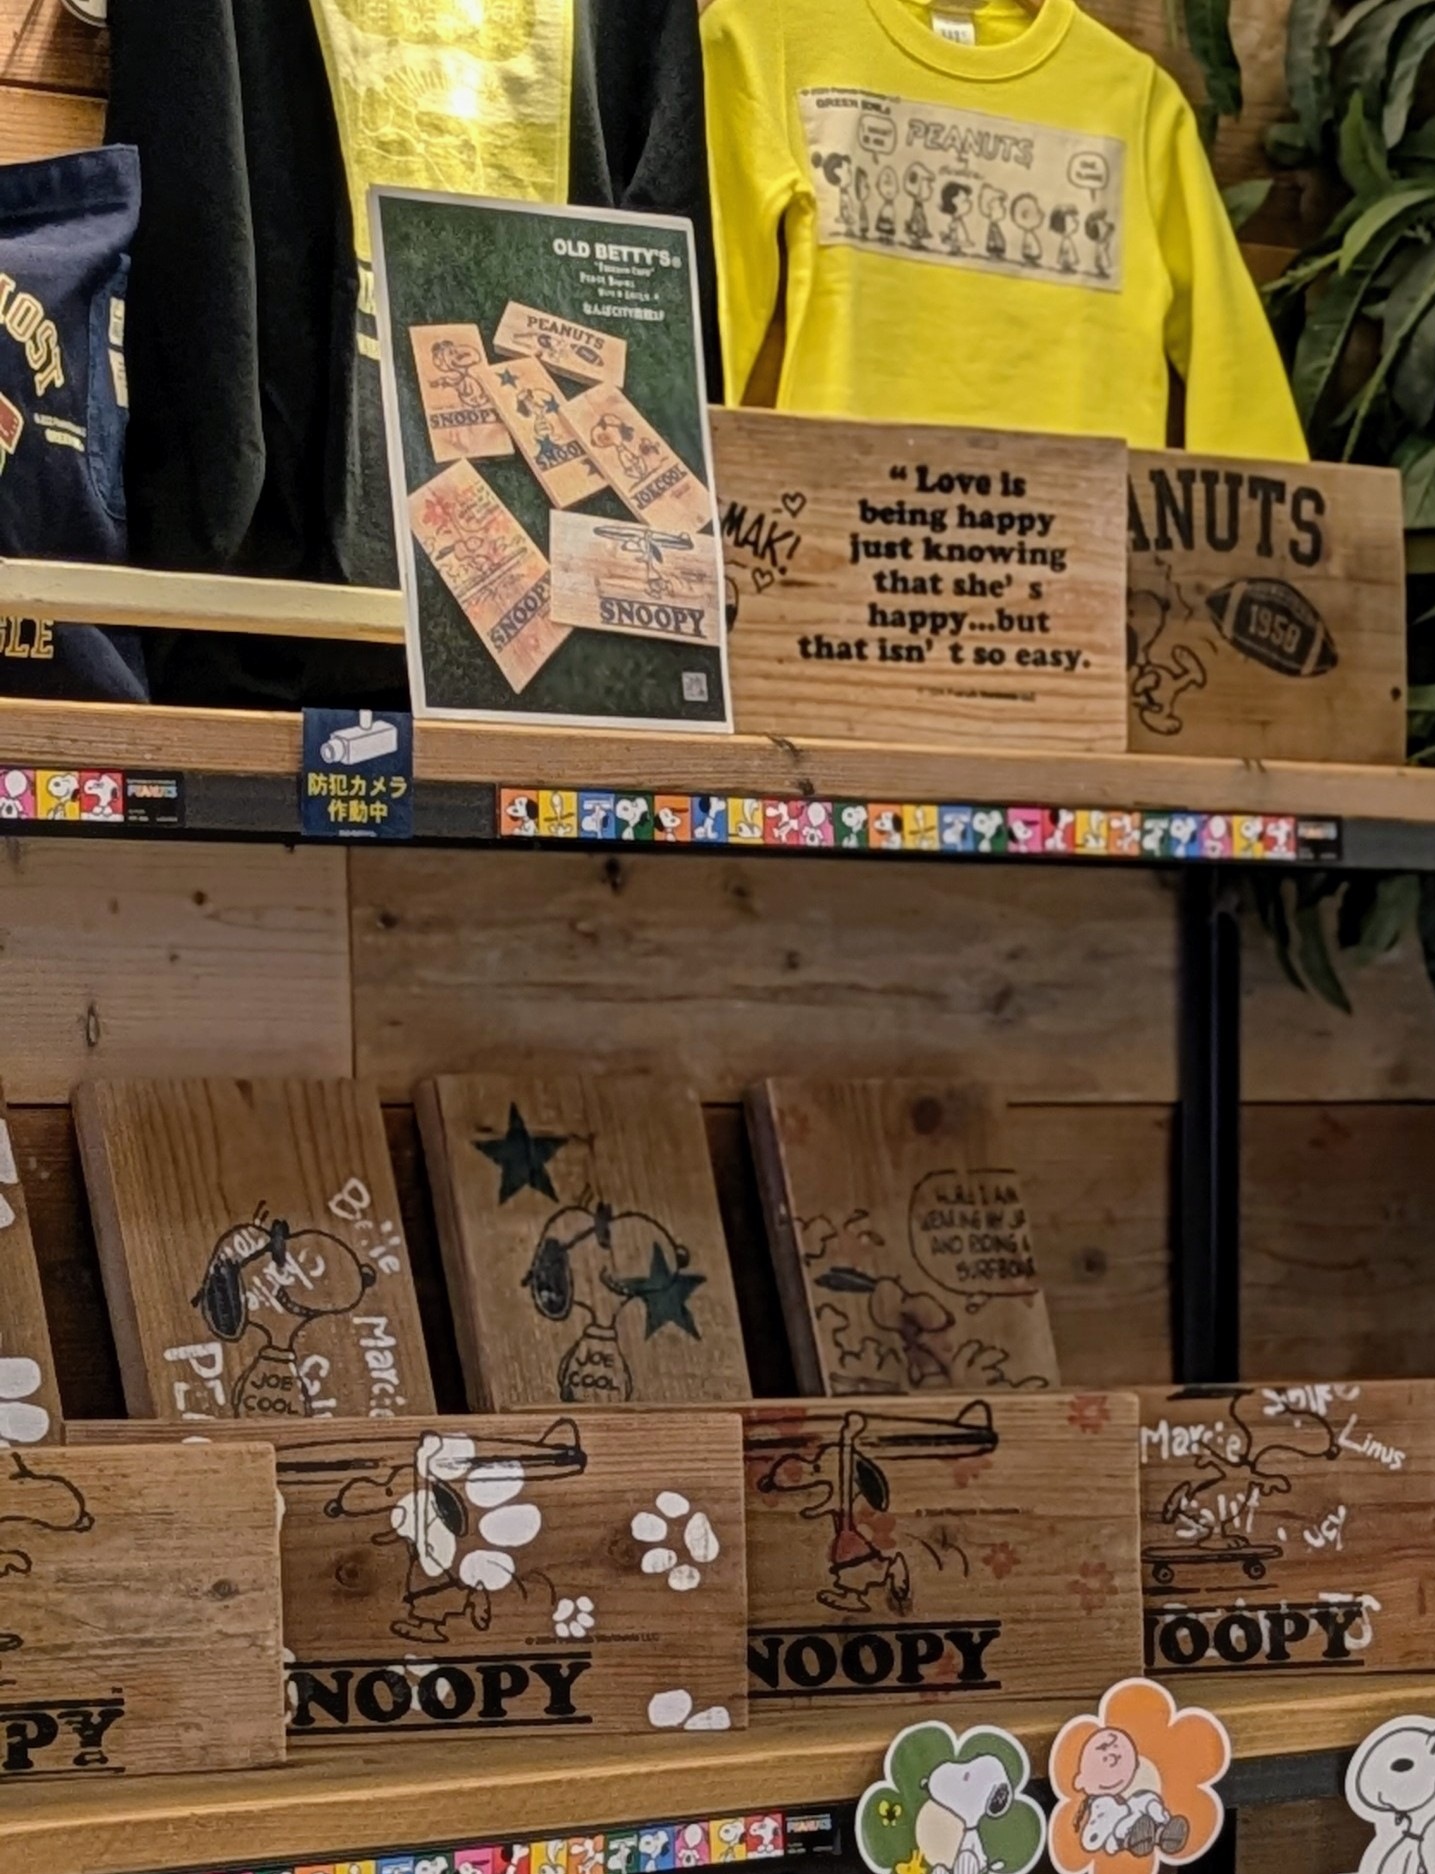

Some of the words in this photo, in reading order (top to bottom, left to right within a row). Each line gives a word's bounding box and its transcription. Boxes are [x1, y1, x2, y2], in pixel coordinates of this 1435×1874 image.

[906, 118, 1034, 170] PEANUTS
[553, 238, 590, 258] OLD
[527, 315, 605, 350] PEANUTS
[1001, 471, 1026, 497] is
[859, 500, 947, 533] being
[957, 504, 1055, 537] happy
[849, 533, 914, 565] just
[922, 537, 1067, 573] knowing
[874, 570, 943, 596] that
[600, 600, 705, 639] SNOOPY
[0, 614, 54, 661] LE
[797, 636, 869, 662] that
[973, 646, 1006, 667] so
[1015, 647, 1091, 671] easy.
[307, 771, 408, 799] 防犯カメラ
[327, 798, 389, 824] 作動中
[576, 1355, 615, 1367] JOE
[251, 1373, 294, 1392] JOE
[568, 1372, 620, 1391] COOL
[243, 1394, 299, 1415] COOL
[1338, 1413, 1406, 1470] Linus
